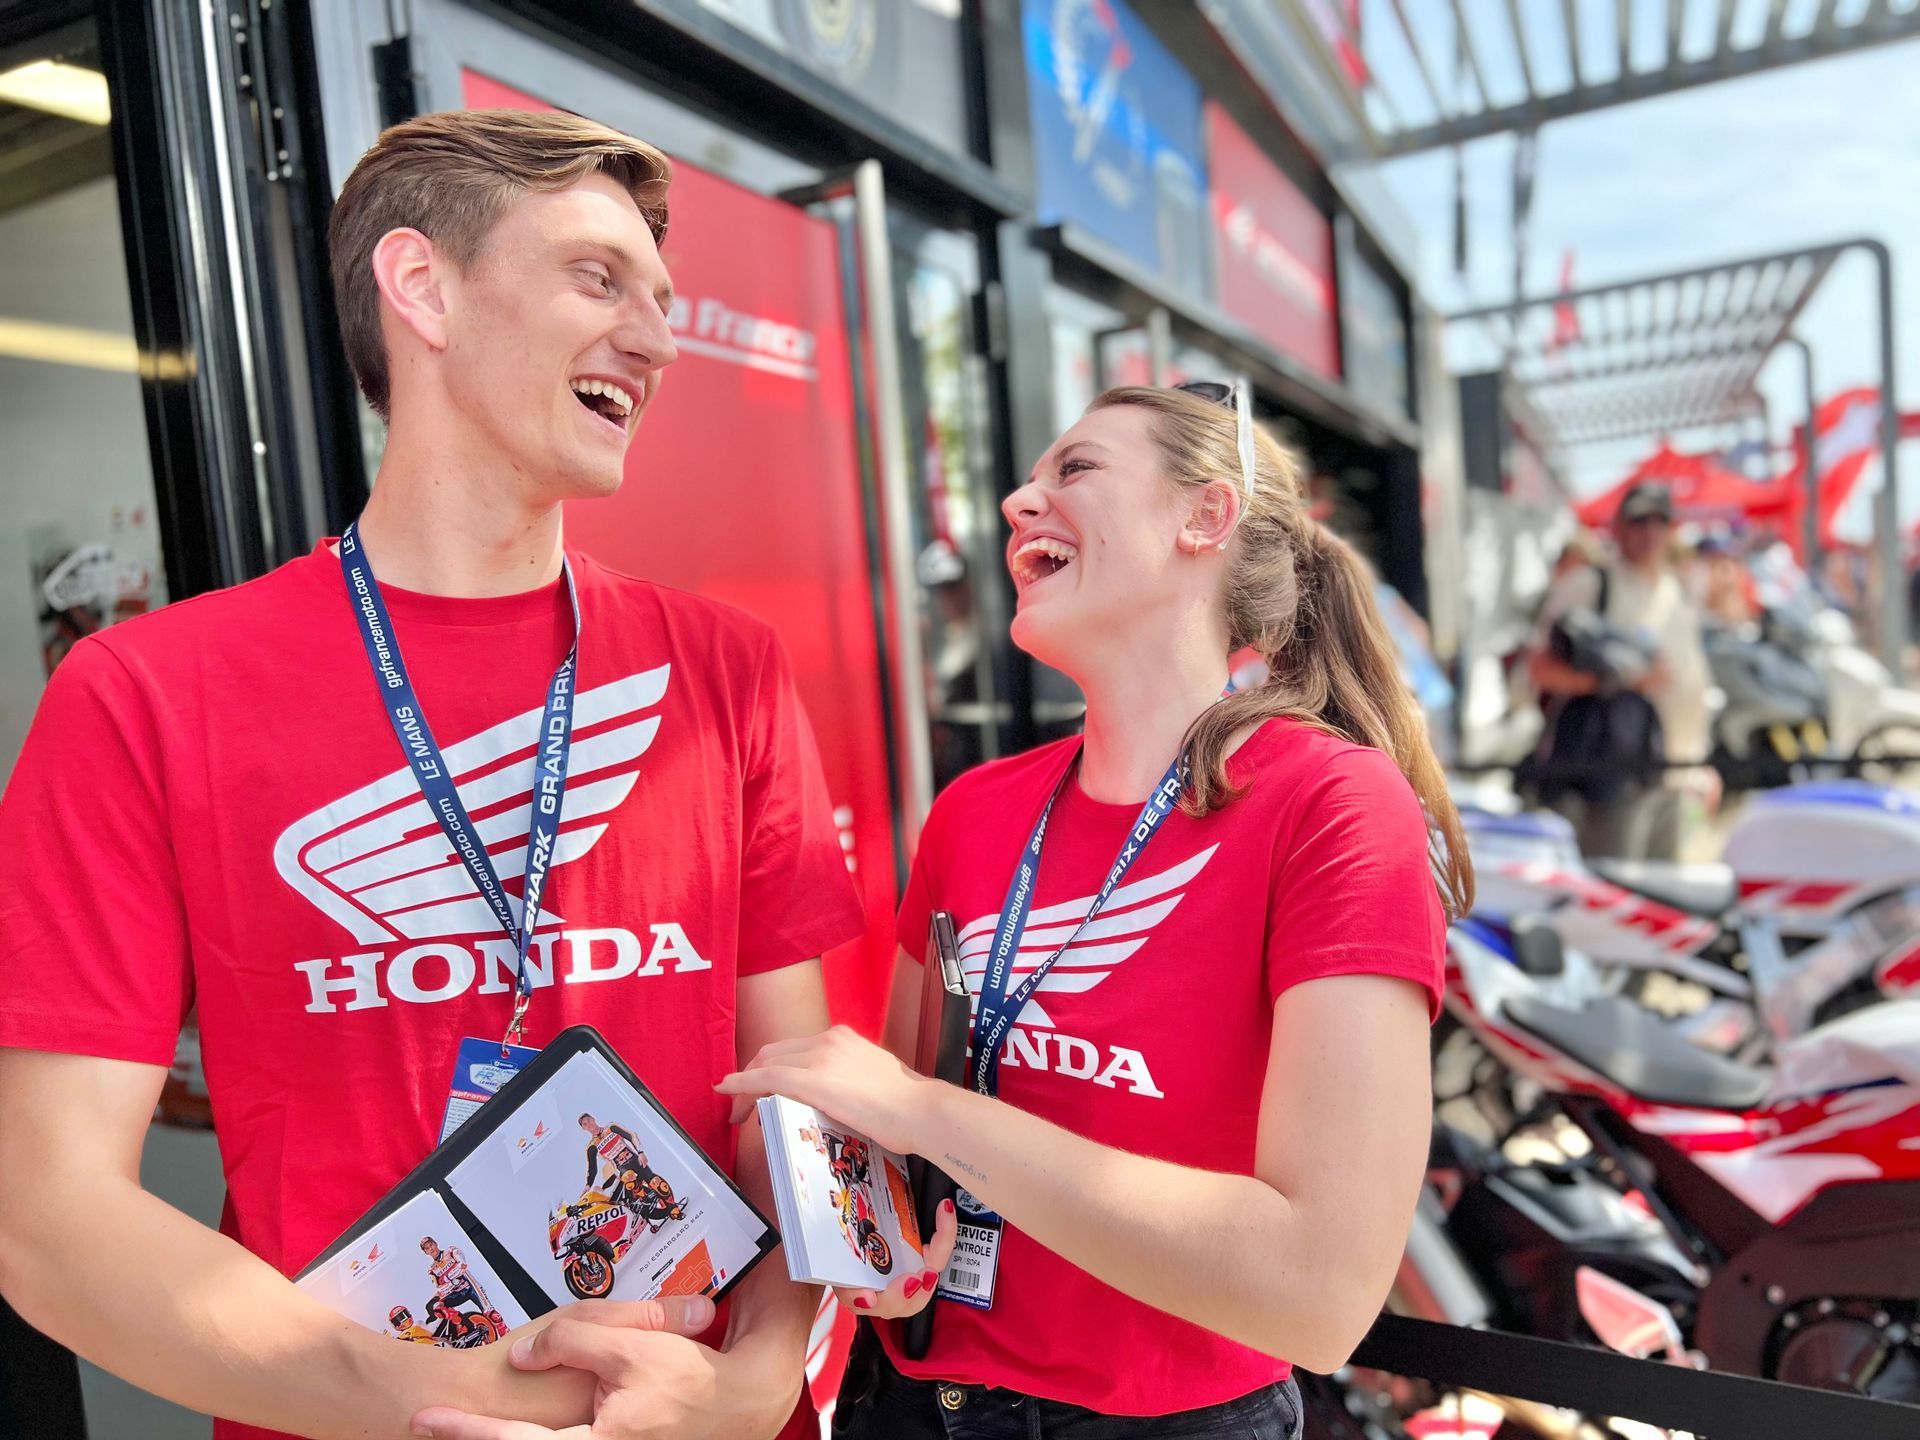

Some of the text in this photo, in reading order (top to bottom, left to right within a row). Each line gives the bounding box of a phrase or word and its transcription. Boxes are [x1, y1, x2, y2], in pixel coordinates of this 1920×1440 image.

[351, 567, 404, 689] gpfrancemoto.com
[395, 705, 432, 758] MANS
[418, 759, 442, 780] LE
[524, 654, 574, 936] SHARK GRAND PRIX
[1102, 841, 1138, 898] PRIX
[1134, 807, 1160, 842] DE
[990, 863, 1032, 989] gpfrancemoto.com
[294, 922, 712, 1013] HONDA
[978, 1015, 1008, 1096] cemoto.com
[1015, 983, 1031, 1003] LE
[1001, 1029, 1165, 1099] NDA
[576, 1205, 627, 1235] REPSOL
[953, 1240, 992, 1257] ONTROLE
[957, 1225, 994, 1243] ERVICE
